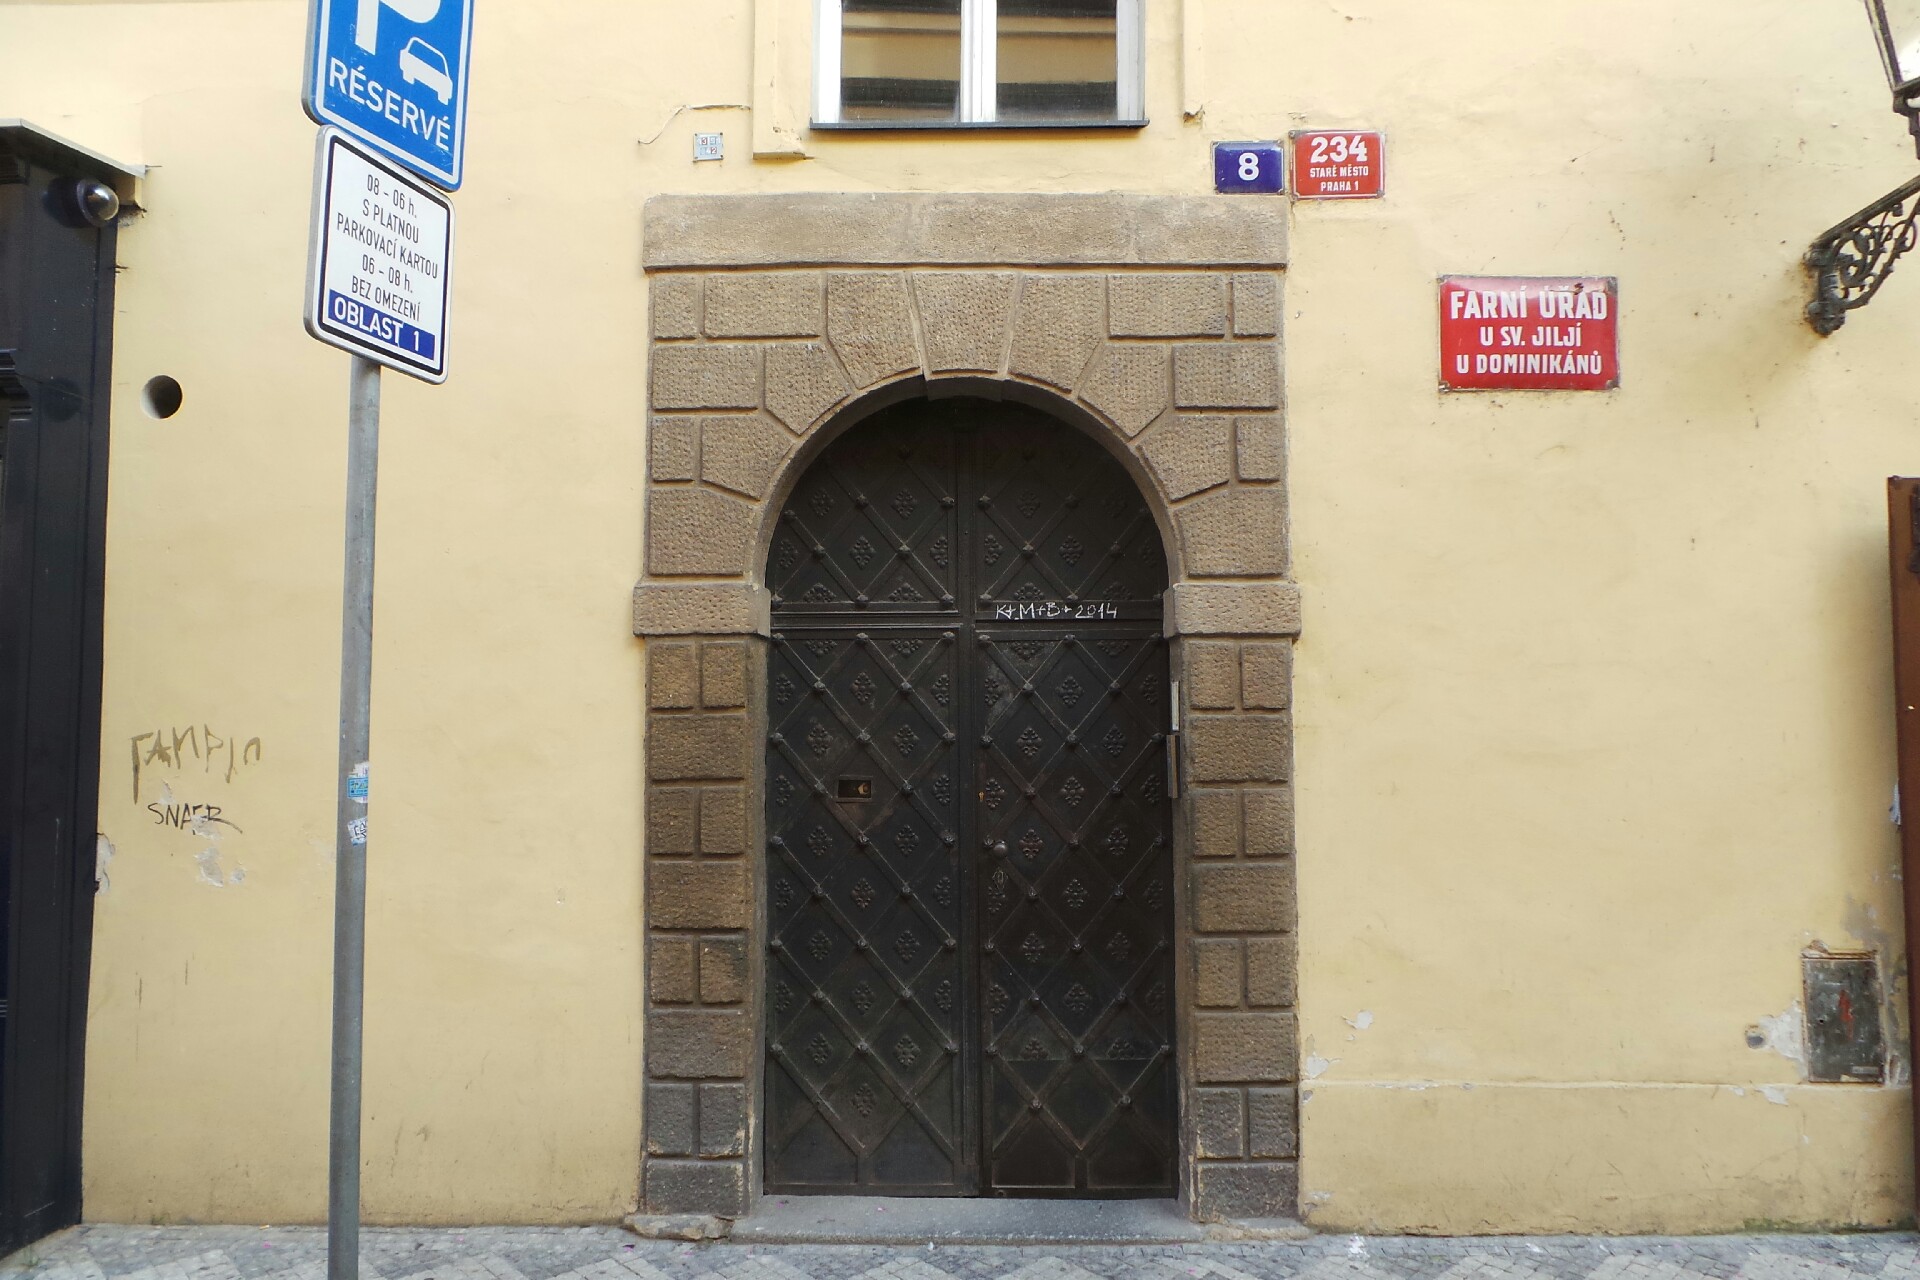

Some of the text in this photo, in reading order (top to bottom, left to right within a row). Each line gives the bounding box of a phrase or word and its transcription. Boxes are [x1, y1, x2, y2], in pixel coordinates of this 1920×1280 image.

[329, 57, 451, 151] RÉSERVÉ
[1238, 152, 1260, 181] 8
[1310, 135, 1368, 164] 234
[1310, 163, 1369, 178] STARÉ MĚSTO
[1320, 180, 1359, 191] PRAHA 1
[367, 174, 379, 196] 08
[393, 189, 405, 210] 06
[408, 197, 417, 218] h.
[362, 198, 419, 243] S PLATNOU
[337, 212, 438, 279] PARKOVACÍ KARTOU
[362, 254, 375, 275] 06
[388, 266, 401, 286] 08
[404, 273, 413, 293] h.
[352, 275, 421, 322] BEZ OMEZENÍ
[1450, 285, 1528, 319] FARNÍ
[334, 296, 420, 352] OBLAST 1
[1480, 322, 1582, 347] U SV. JILJÍ
[1456, 350, 1602, 375] U DOMINIKÁNŮ
